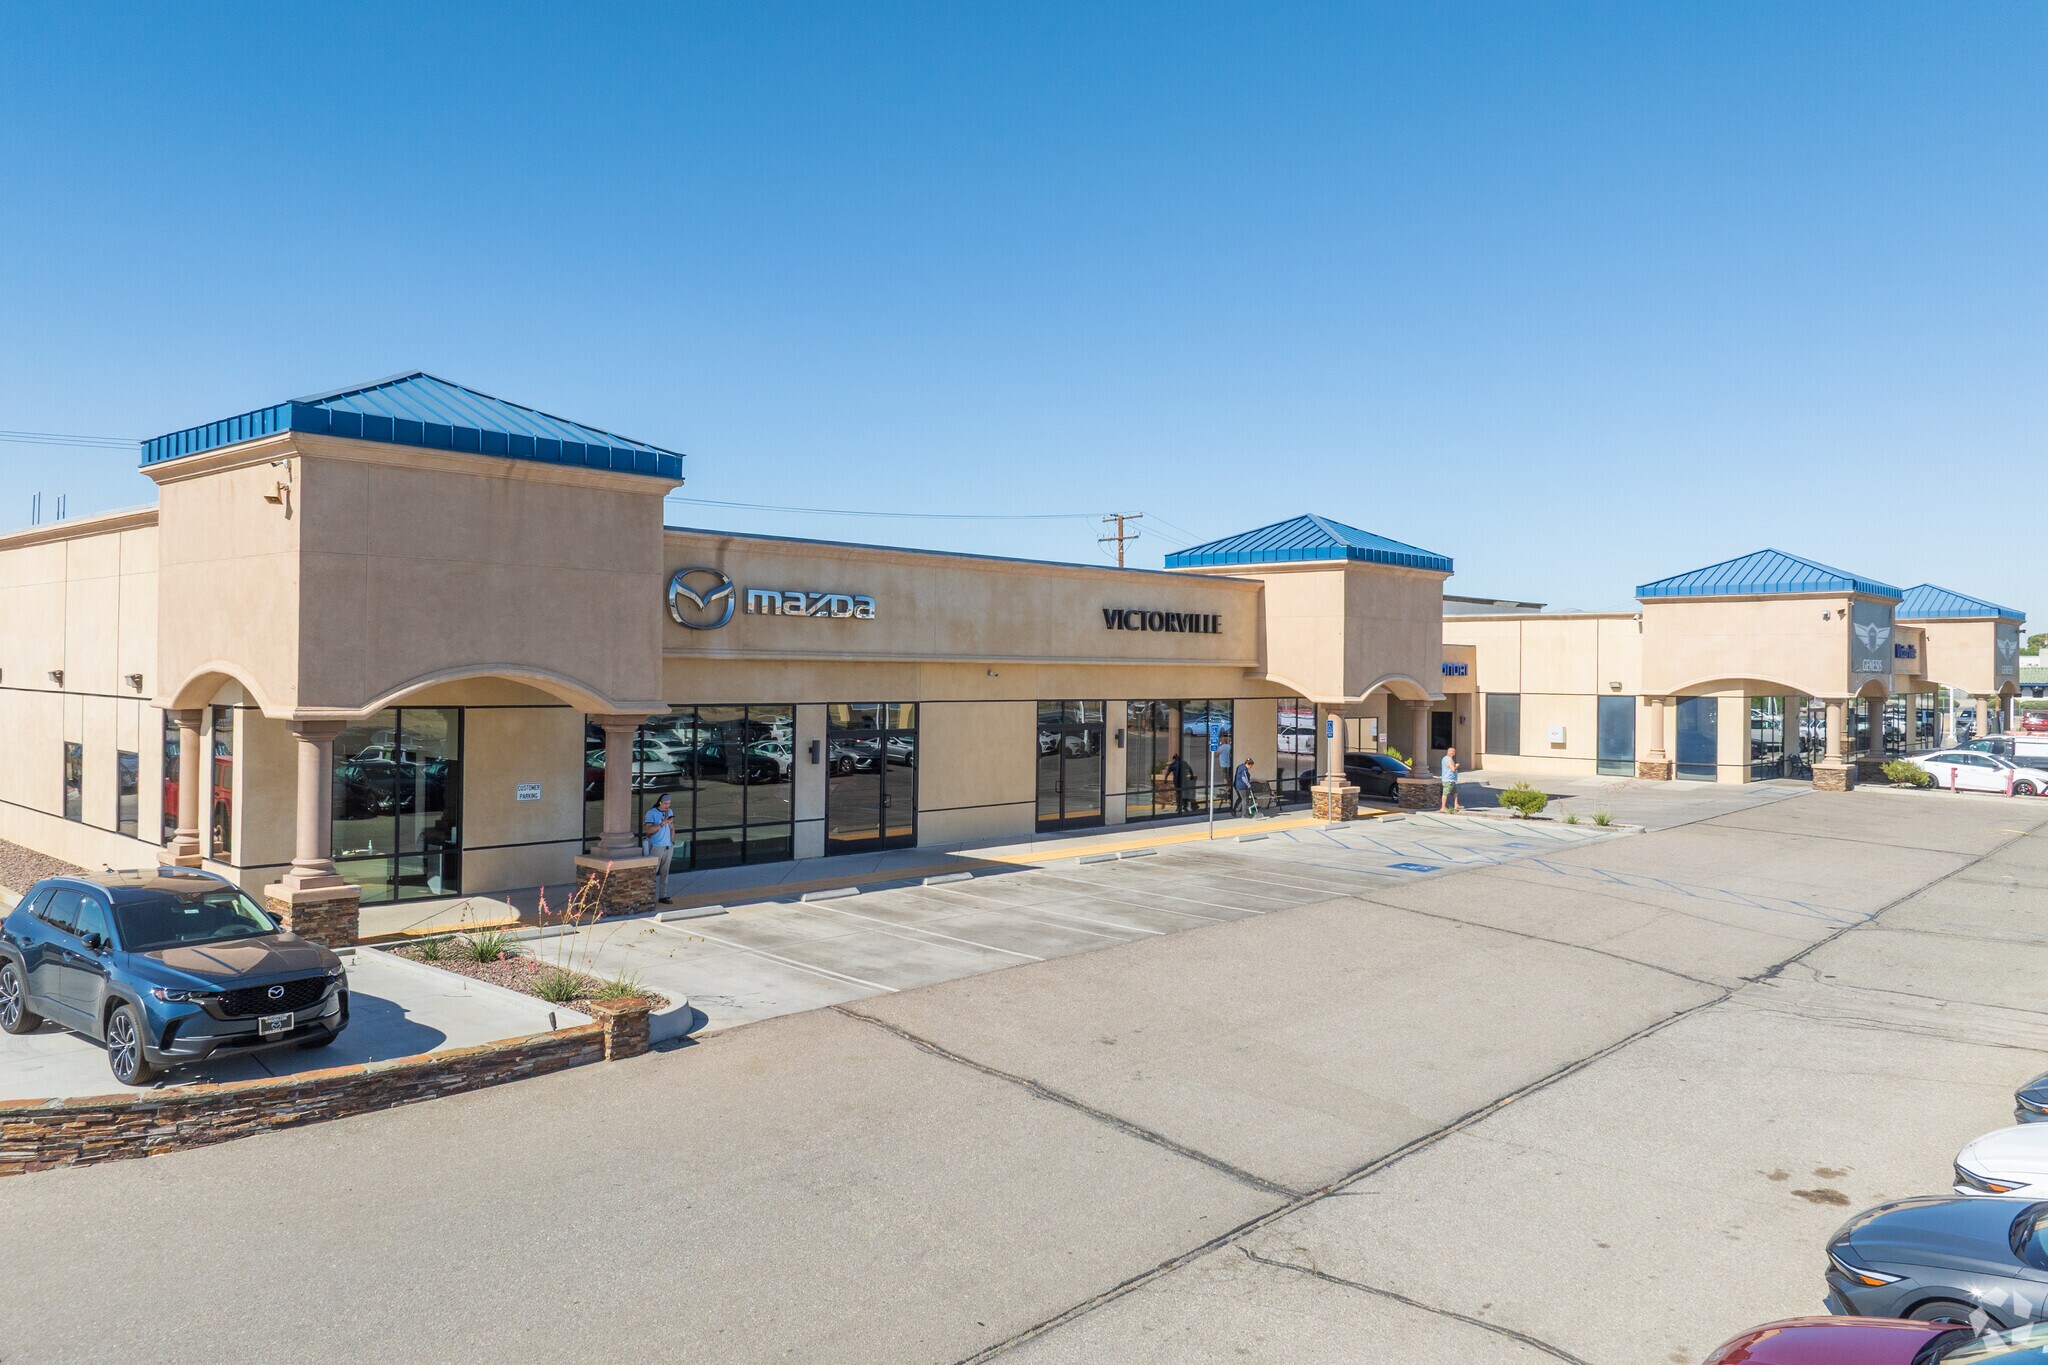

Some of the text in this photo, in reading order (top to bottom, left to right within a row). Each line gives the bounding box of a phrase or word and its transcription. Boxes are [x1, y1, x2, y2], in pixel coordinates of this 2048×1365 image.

[1102, 608, 1222, 634] VICTORVILLE
[1862, 659, 1883, 671] GENESIS
[519, 792, 538, 800] PARKING
